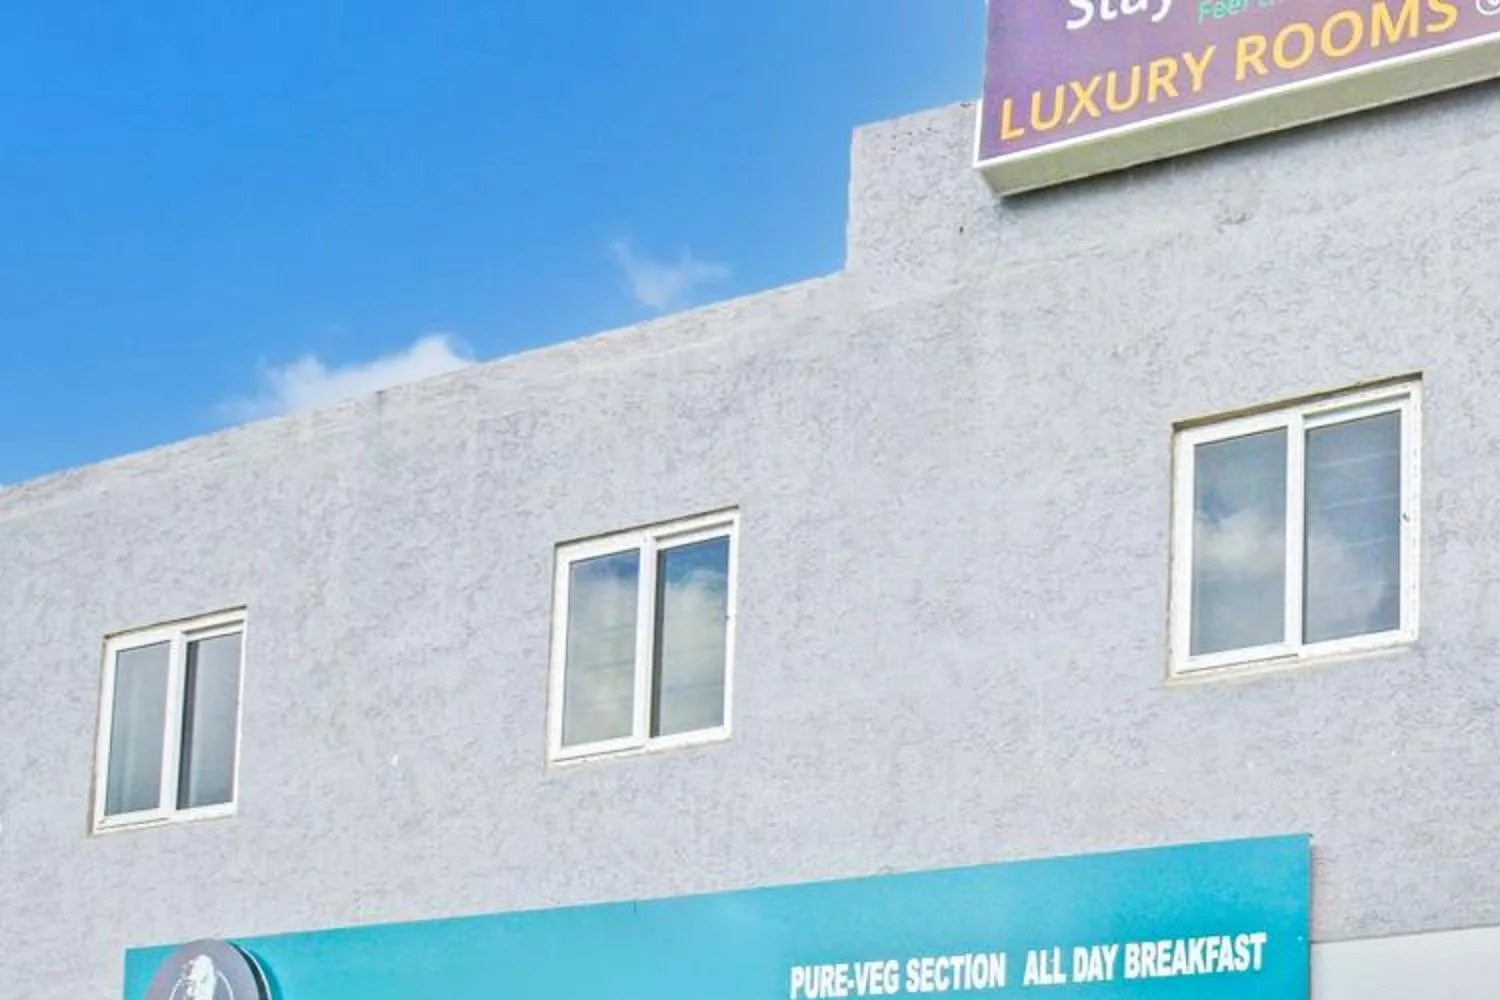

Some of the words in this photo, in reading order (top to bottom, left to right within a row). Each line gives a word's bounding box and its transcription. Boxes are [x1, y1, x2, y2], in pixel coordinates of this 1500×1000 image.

[1001, 45, 1217, 140] LUXURY
[1234, 0, 1458, 81] ROOMS
[790, 962, 900, 1000] PURE-VEG
[905, 952, 1006, 992] SECTION
[1023, 946, 1066, 987] ALL
[1072, 943, 1120, 982] DAY
[1124, 931, 1268, 979] BREAKFAST
